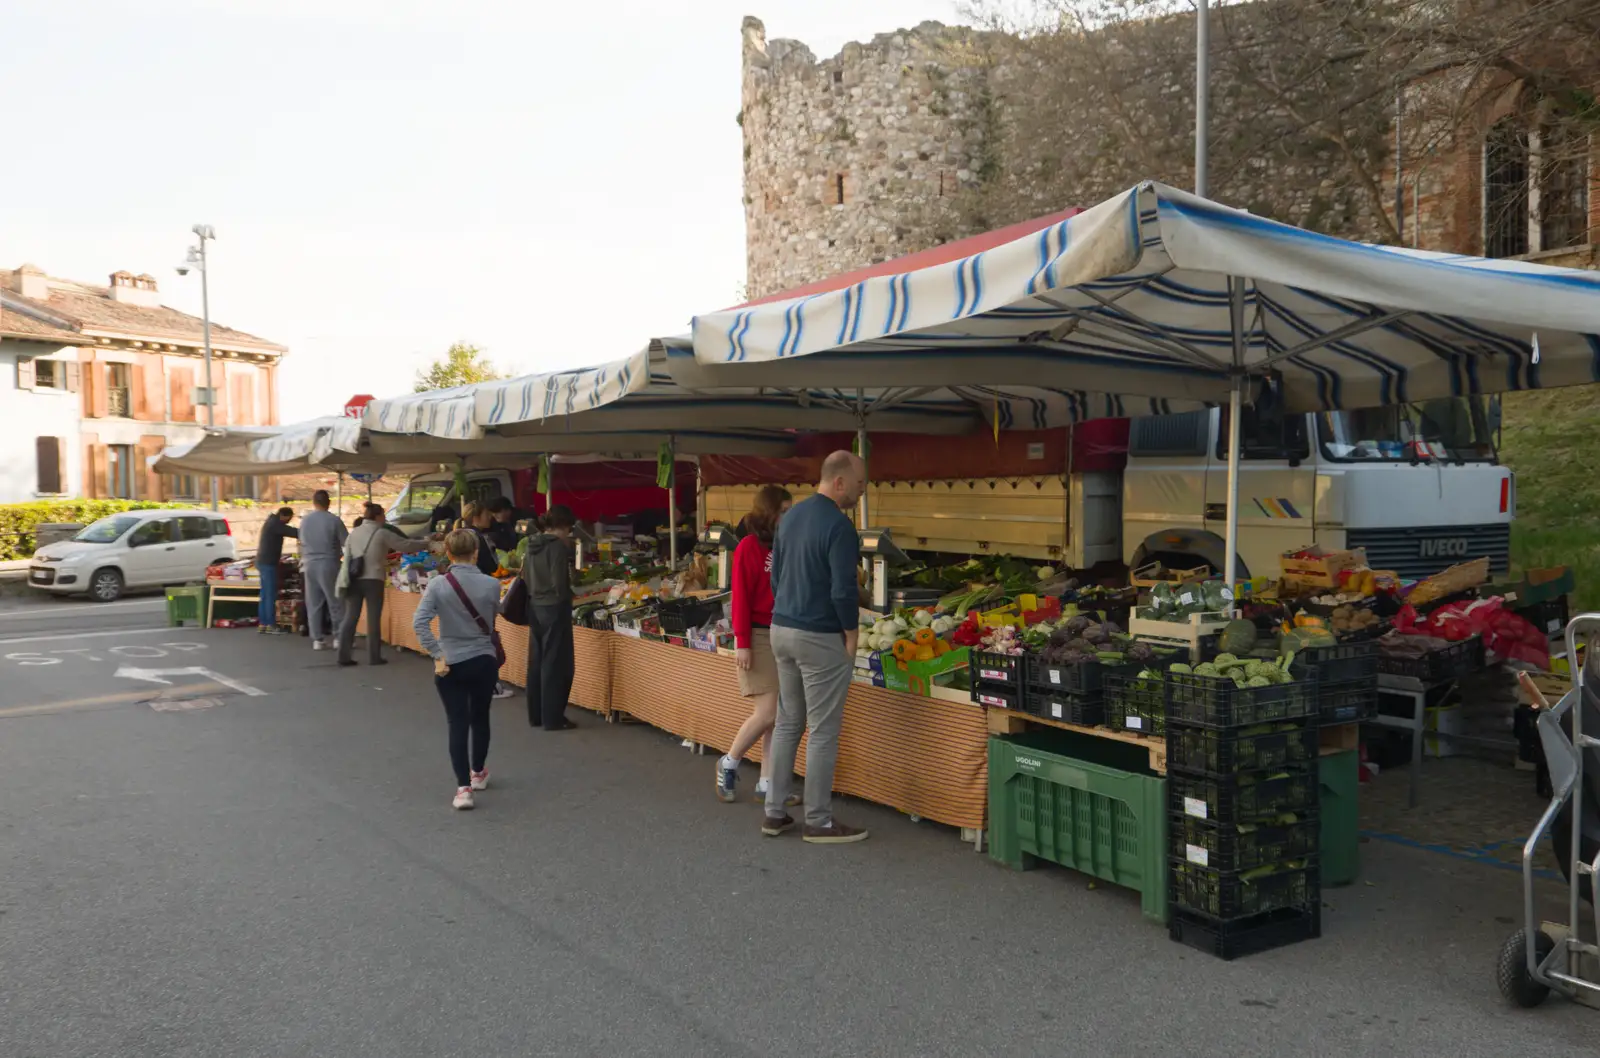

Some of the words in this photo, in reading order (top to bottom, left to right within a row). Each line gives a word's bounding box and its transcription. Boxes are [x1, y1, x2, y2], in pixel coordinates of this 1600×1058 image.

[346, 406, 369, 418] STO
[1419, 538, 1468, 557] IVECO
[4, 642, 209, 666] STOP
